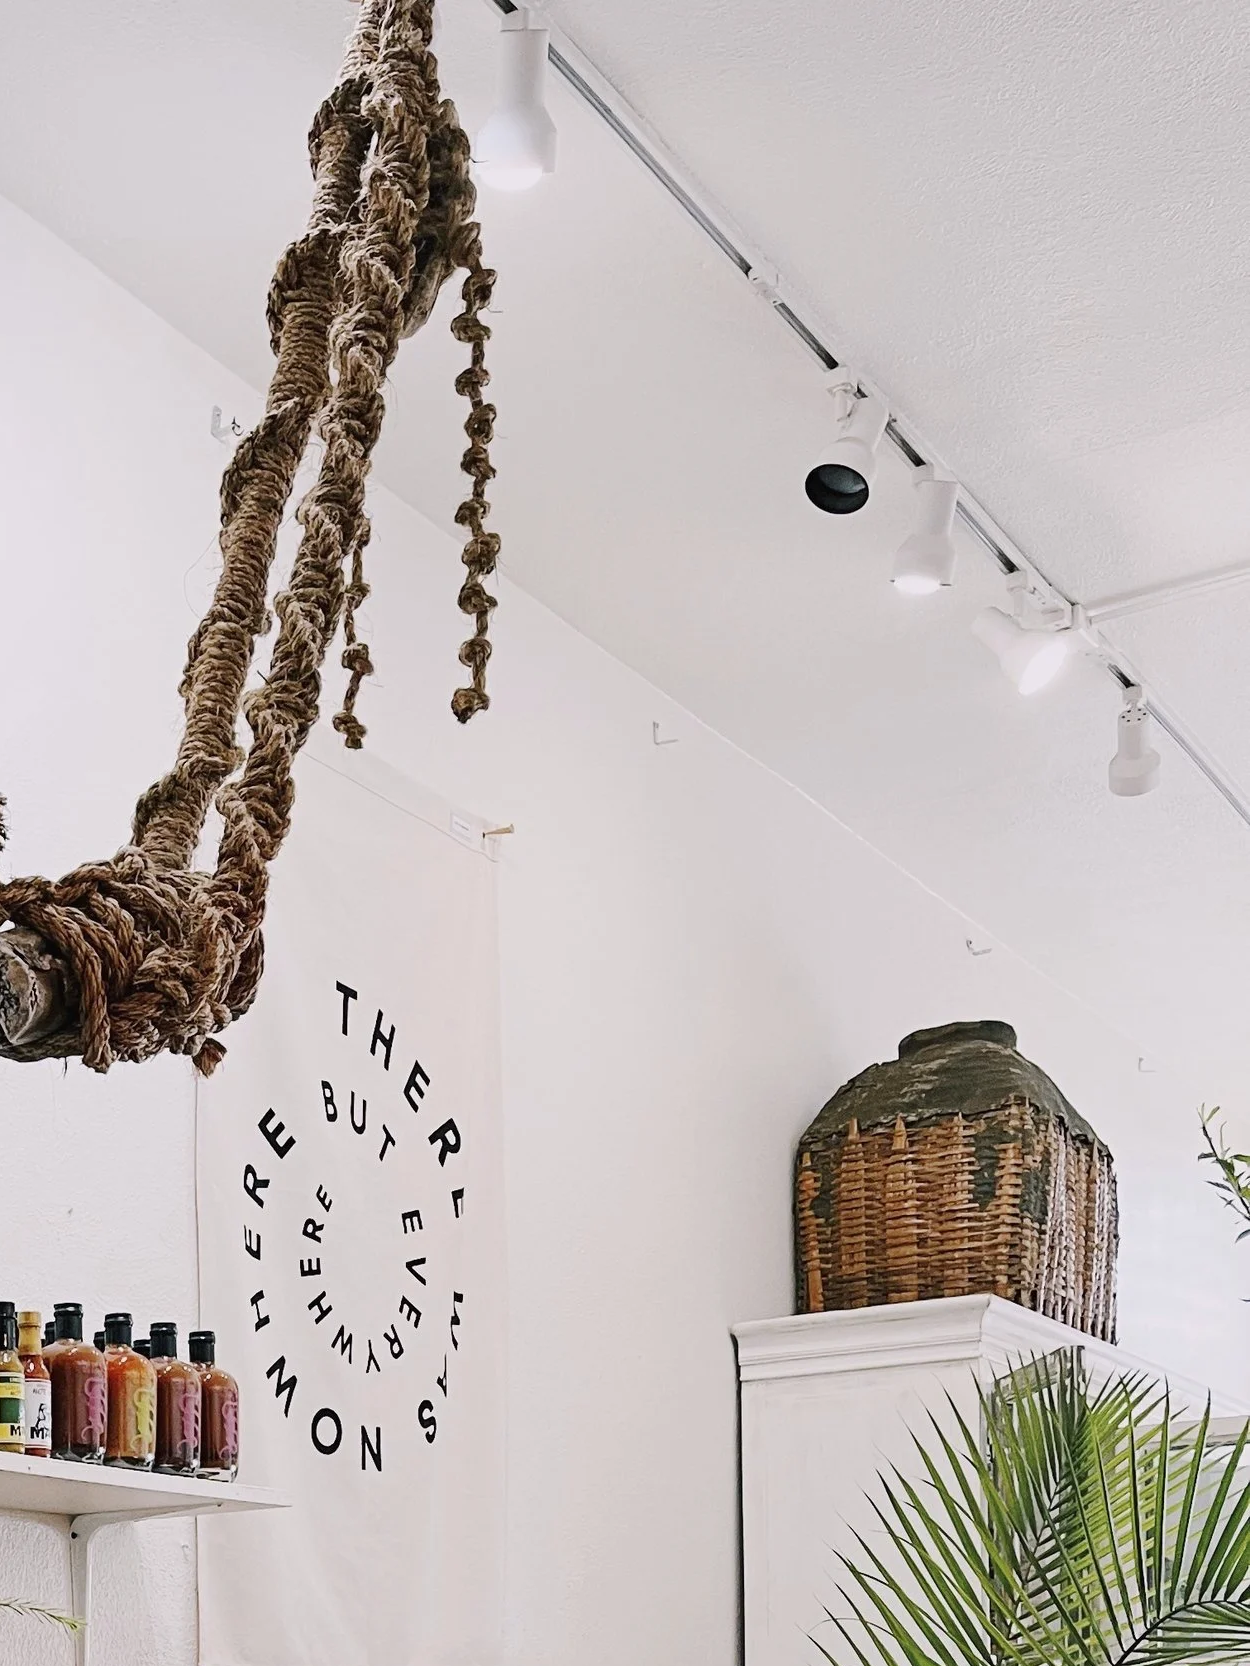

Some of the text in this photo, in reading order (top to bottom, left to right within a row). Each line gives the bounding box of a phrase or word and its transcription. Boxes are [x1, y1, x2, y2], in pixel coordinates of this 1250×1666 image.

[243, 1107, 383, 1472] NOWHERE
[299, 1080, 427, 1374] BUT EVERYWHERE
